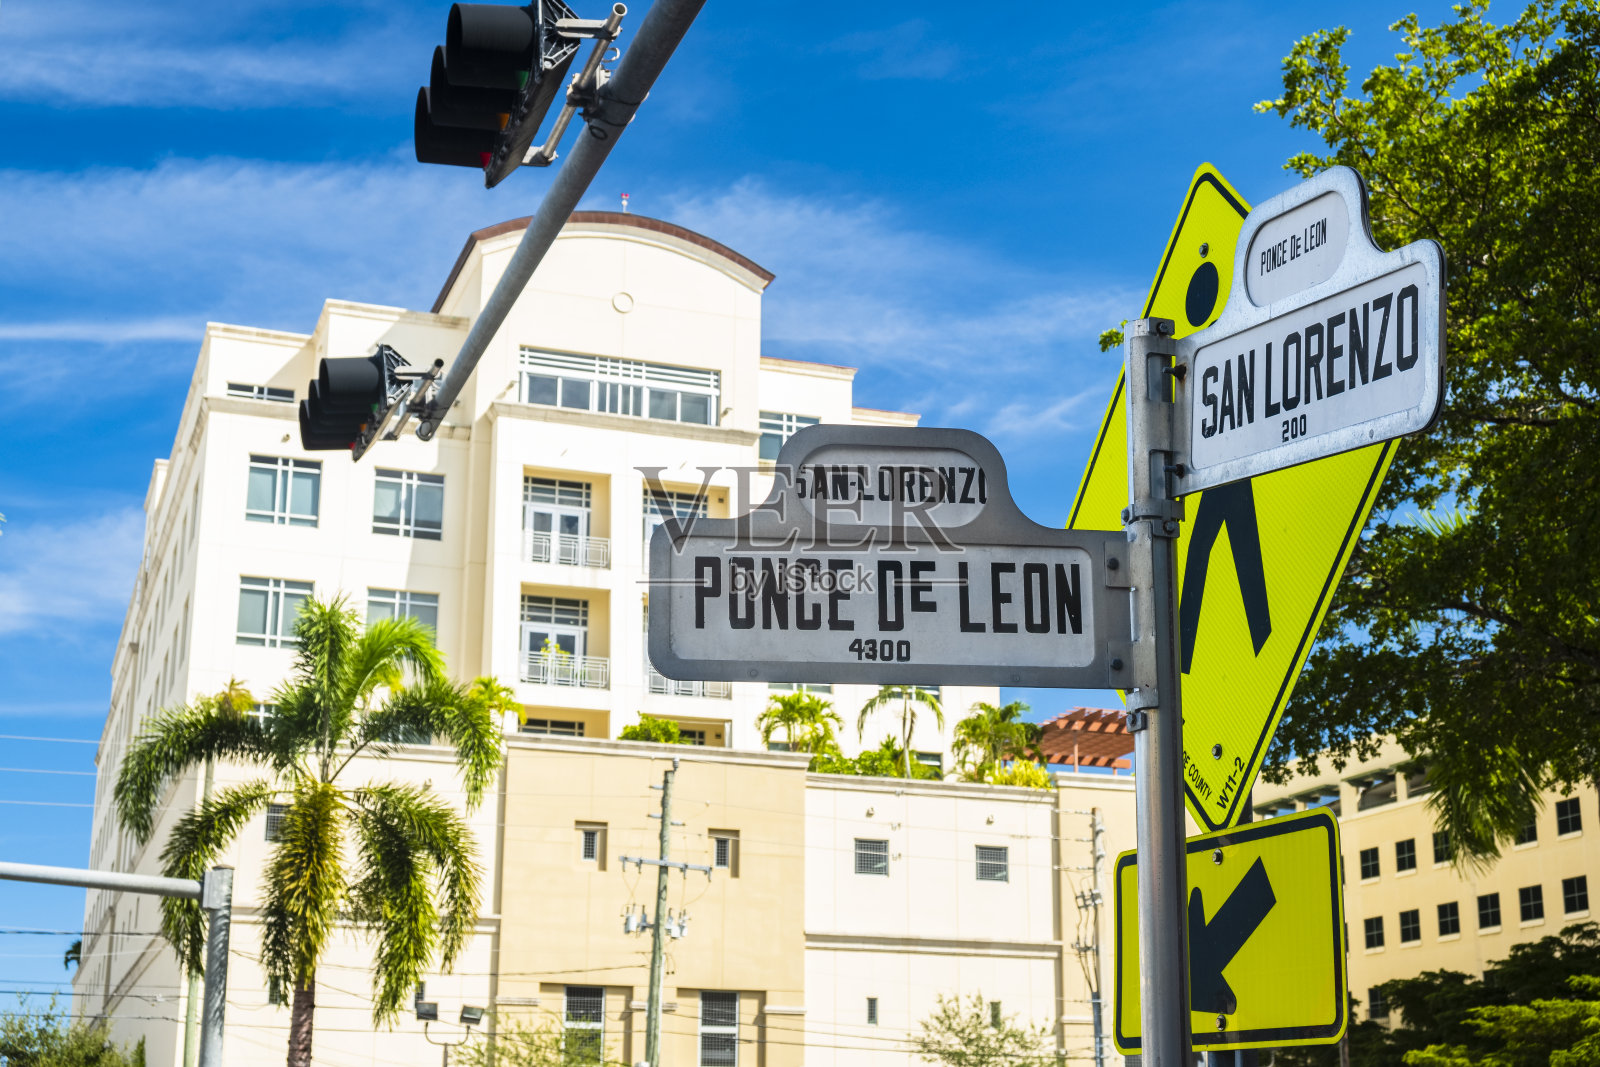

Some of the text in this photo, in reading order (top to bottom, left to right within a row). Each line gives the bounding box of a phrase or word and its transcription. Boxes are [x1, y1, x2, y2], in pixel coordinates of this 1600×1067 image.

[1261, 239, 1287, 276] PONCE
[1304, 217, 1327, 253] LEON
[1201, 283, 1419, 440] SAN LORENZO
[1282, 413, 1307, 442] 200
[694, 555, 1083, 635] PONCE DE LEON
[848, 638, 912, 663] 4300
[1188, 763, 1212, 801] COUNTY
[1217, 756, 1245, 809] W11-2
